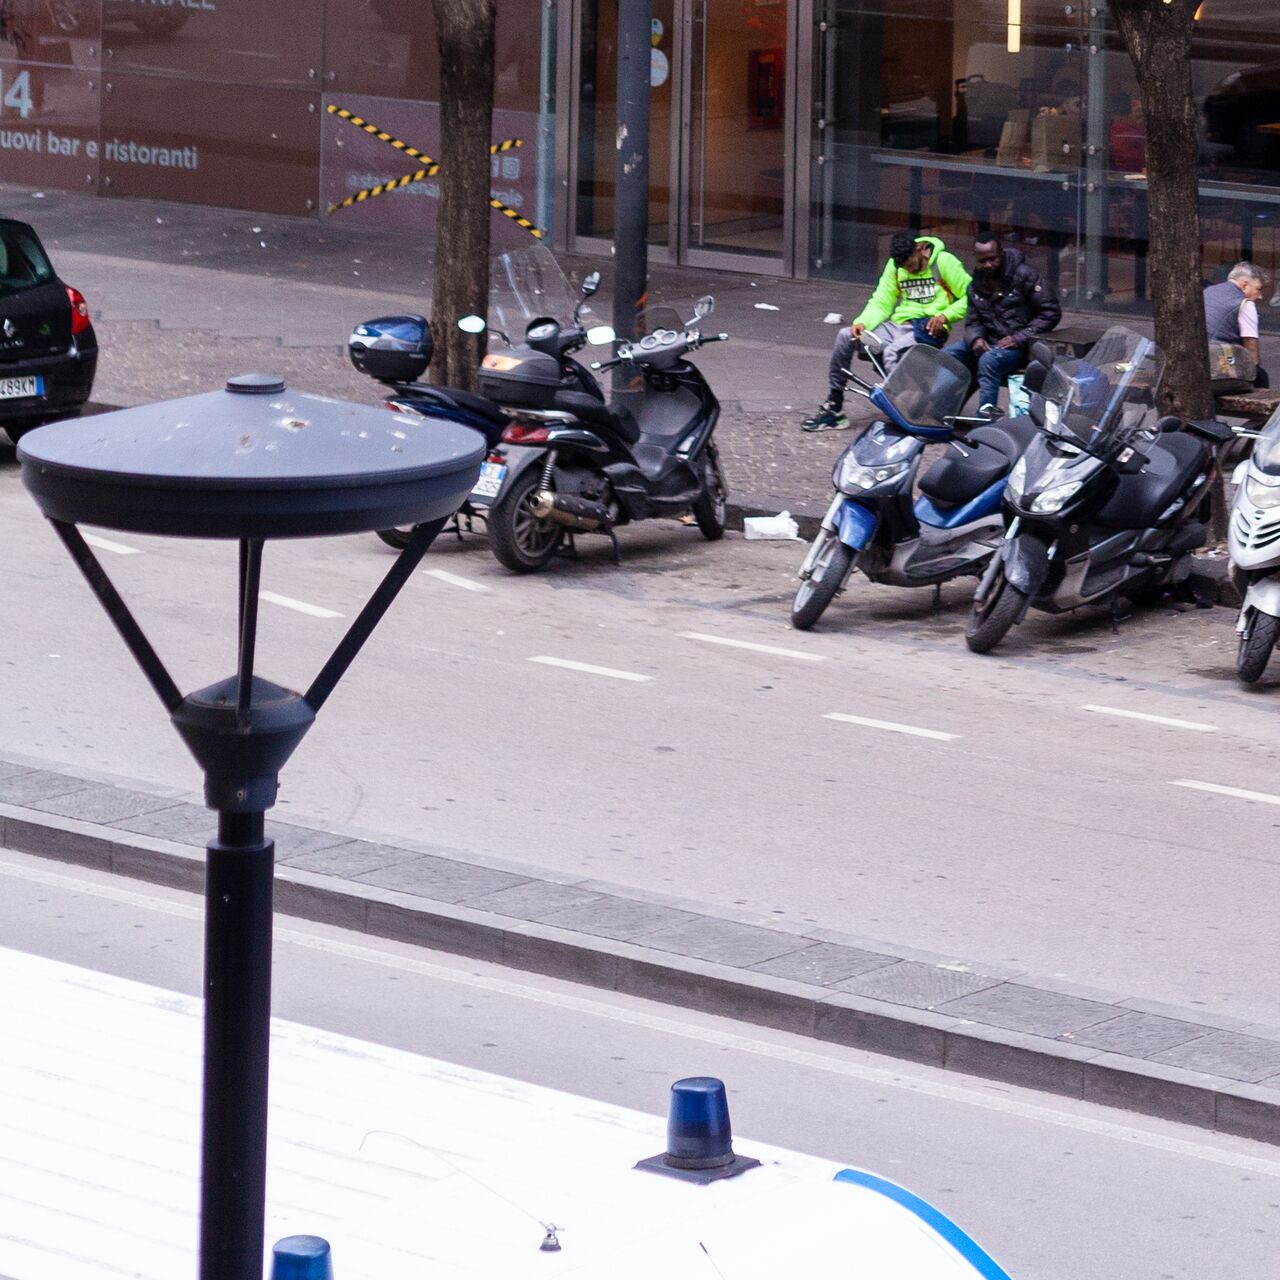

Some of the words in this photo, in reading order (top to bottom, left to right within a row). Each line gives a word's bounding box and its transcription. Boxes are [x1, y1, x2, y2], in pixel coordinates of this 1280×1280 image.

[47, 131, 79, 158] bar
[86, 143, 98, 159] e
[105, 138, 199, 170] ristoranti
